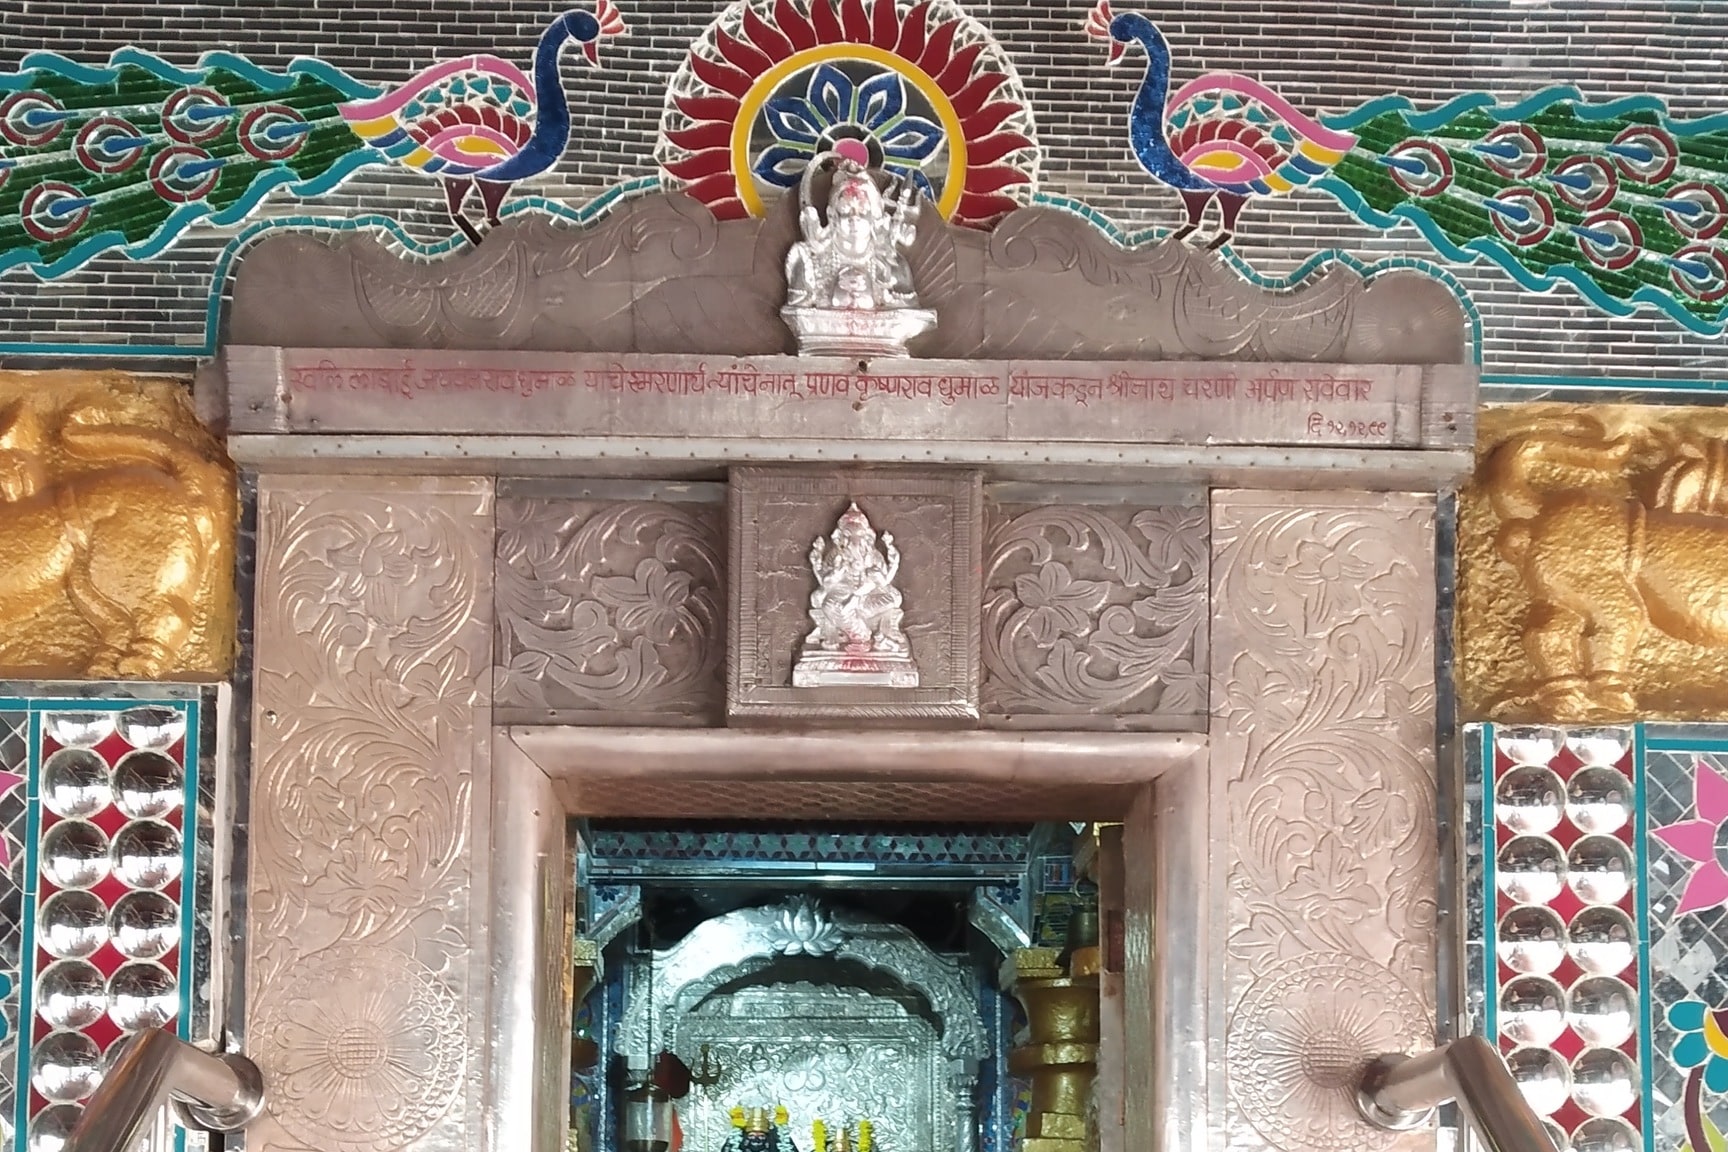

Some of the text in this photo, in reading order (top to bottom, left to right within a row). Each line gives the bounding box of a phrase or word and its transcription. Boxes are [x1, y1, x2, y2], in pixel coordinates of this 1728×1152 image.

[805, 373, 850, 398] प्रणव
[855, 375, 932, 402] कृष्णराव
[937, 376, 1000, 406] धुमाळ
[1106, 370, 1177, 402] श्रीनाथ
[1245, 368, 1302, 403] अर्पण
